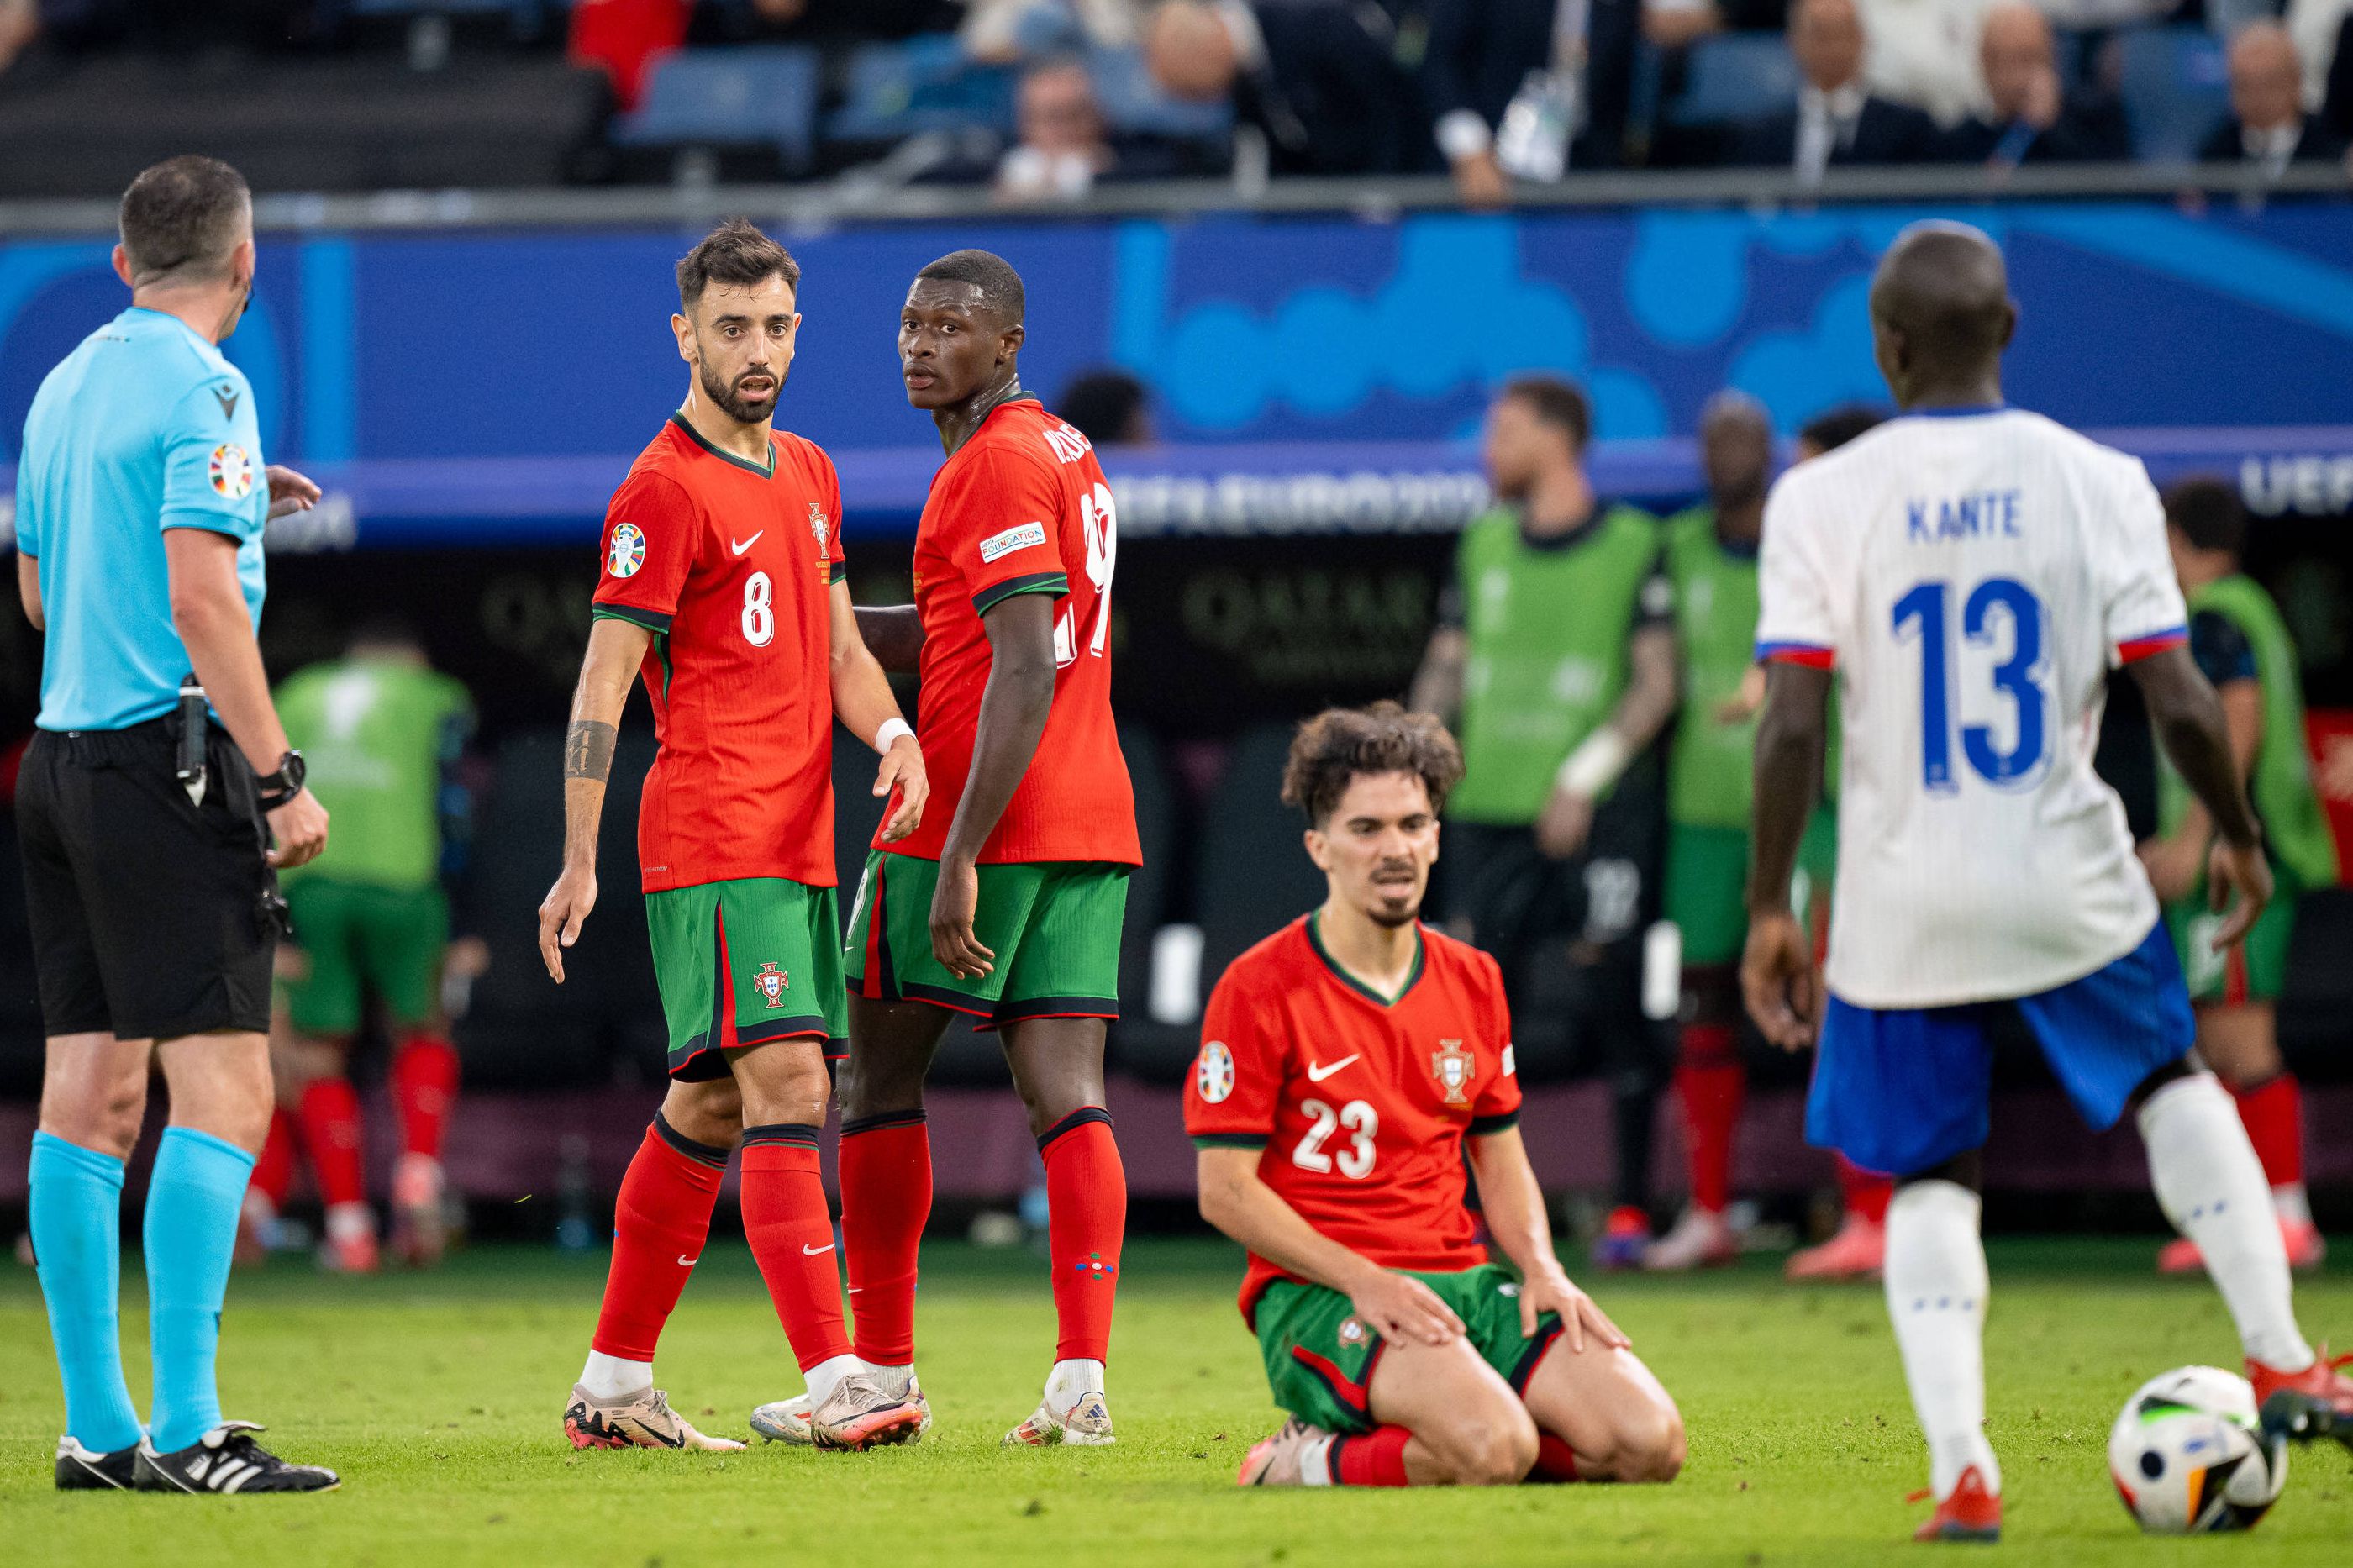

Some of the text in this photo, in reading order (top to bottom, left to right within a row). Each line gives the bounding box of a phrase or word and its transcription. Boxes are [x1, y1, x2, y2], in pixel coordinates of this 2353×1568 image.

[982, 529, 1043, 556] FOUNDATION
[1905, 489, 2022, 544] KANTE
[741, 571, 775, 648] 8
[1891, 576, 2055, 797] 13
[1292, 1097, 1379, 1180] 23
